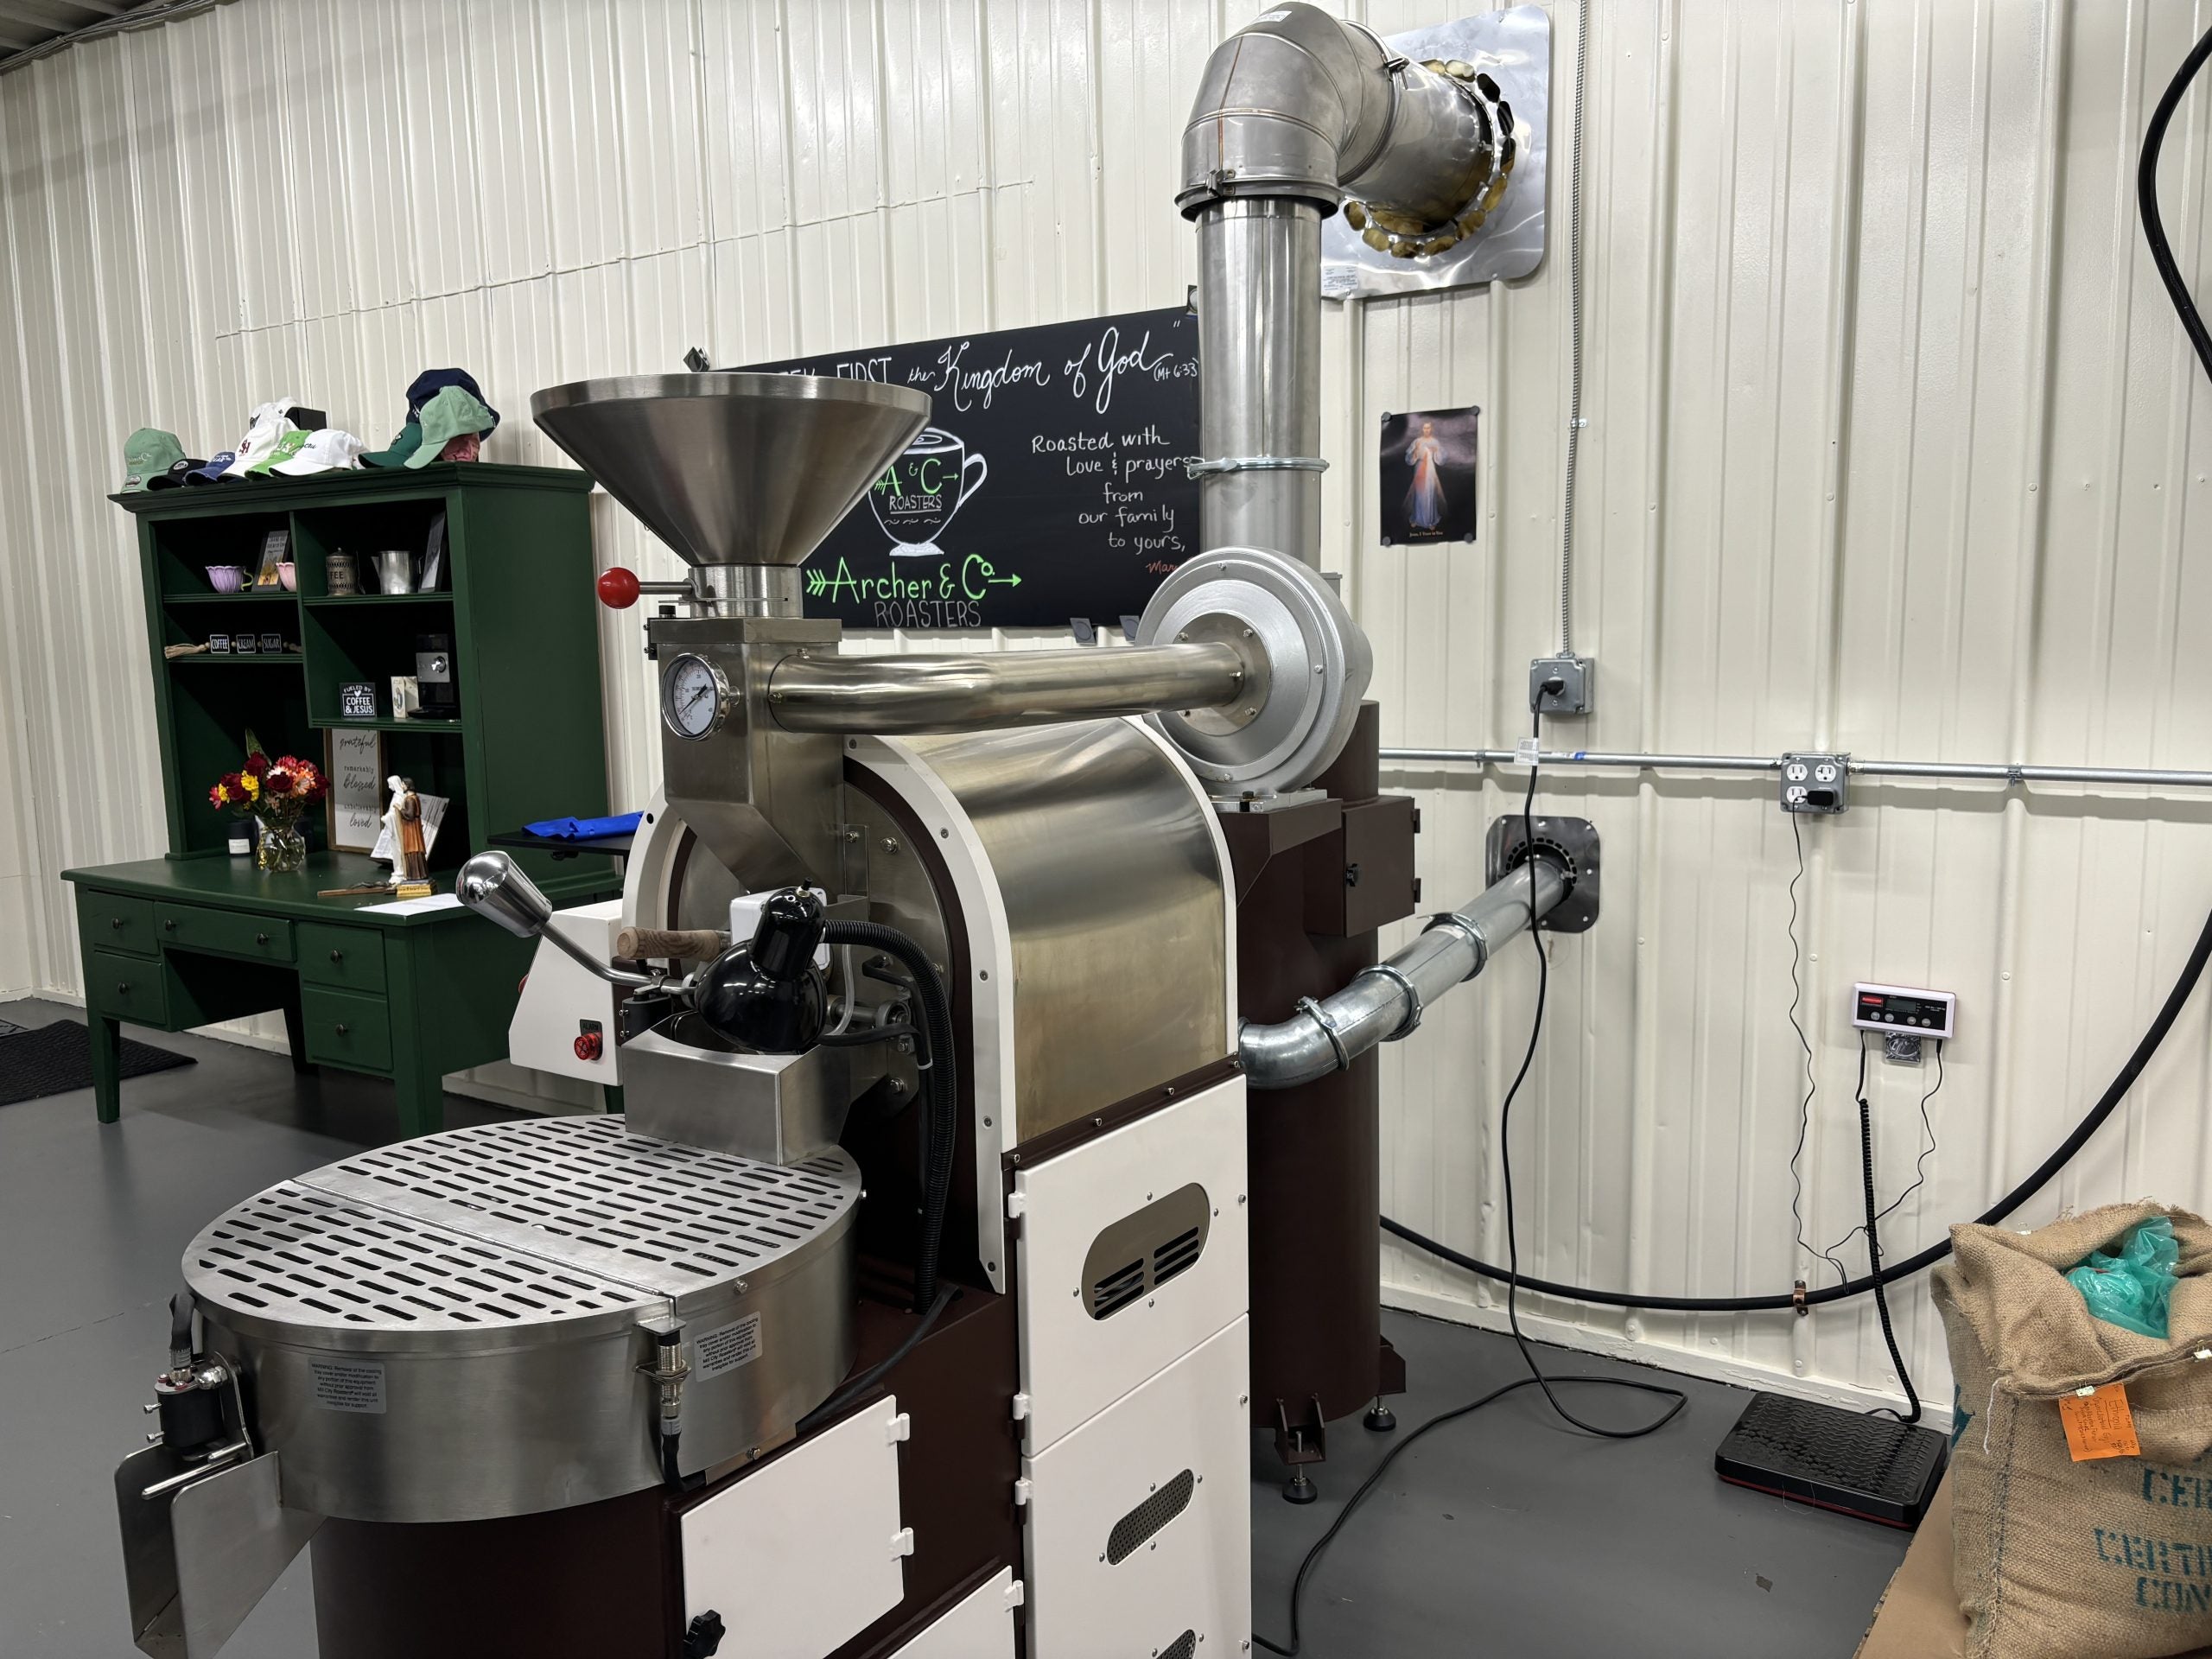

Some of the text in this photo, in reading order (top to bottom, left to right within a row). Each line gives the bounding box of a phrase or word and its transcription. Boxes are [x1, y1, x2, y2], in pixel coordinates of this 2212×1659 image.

[934, 340, 1050, 411] Kingdom
[1065, 342, 1092, 397] of
[1096, 327, 1173, 414] God
[1032, 424, 1171, 454] Roasted with
[920, 458, 943, 494] C
[889, 495, 943, 510] ROASTERS
[1103, 482, 1143, 504] from
[1078, 505, 1174, 532] our family
[1109, 532, 1185, 555] to yours,
[832, 556, 931, 604] Archer
[939, 563, 956, 599] &
[874, 601, 982, 628] ROASTERS
[212, 639, 228, 650] COFFEE
[238, 639, 255, 650] CREAM
[264, 638, 280, 649] SUGAR
[346, 696, 371, 706] COFFEE
[346, 705, 373, 714] & JESUS
[340, 734, 377, 754] grateful
[343, 772, 377, 791] blessed
[349, 812, 372, 829] loved
[582, 1022, 599, 1031] ALARM
